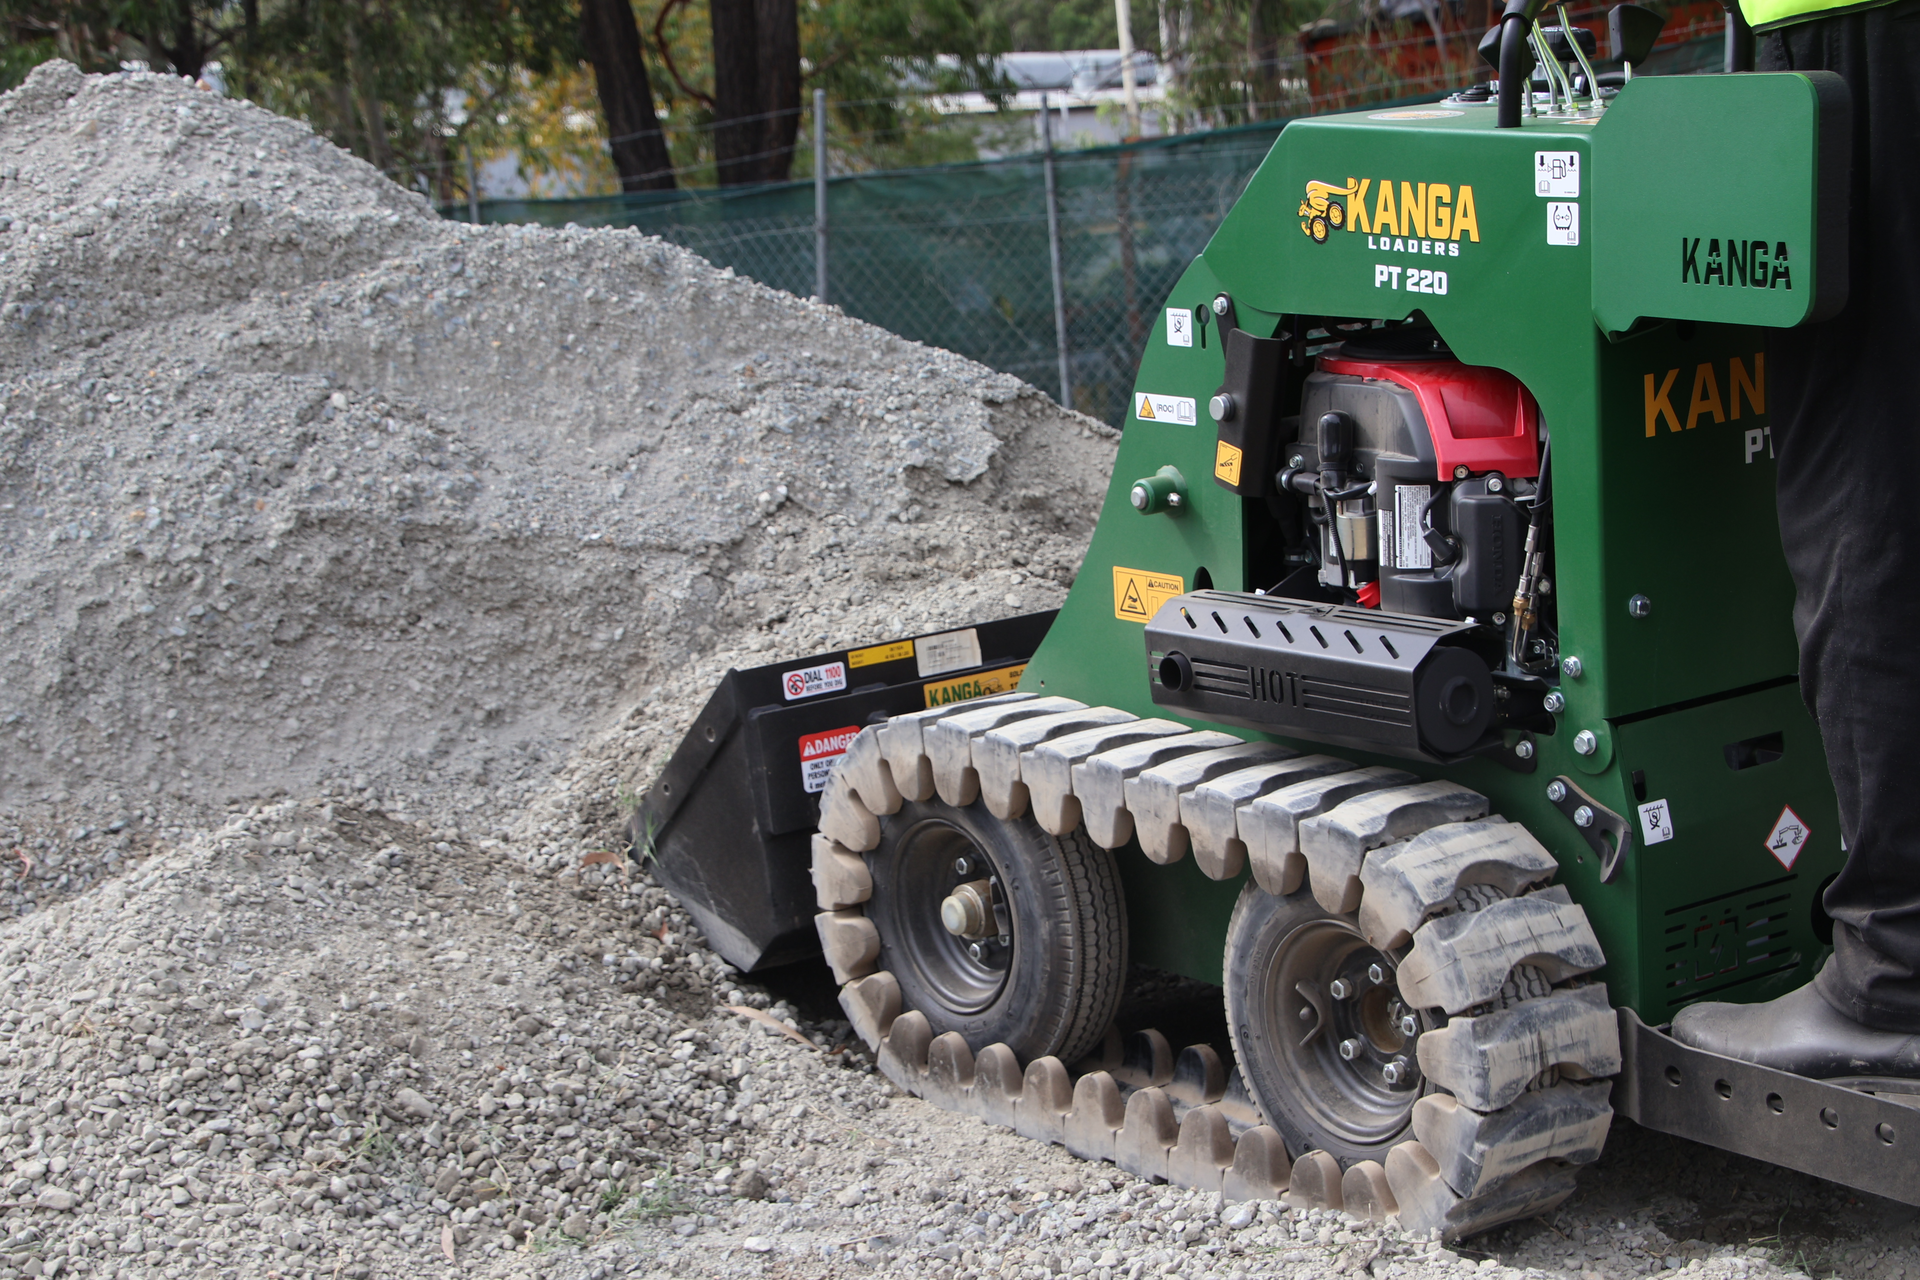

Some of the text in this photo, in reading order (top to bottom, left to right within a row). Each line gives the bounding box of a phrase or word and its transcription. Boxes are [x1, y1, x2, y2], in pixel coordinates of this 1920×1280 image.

[1346, 177, 1481, 243] KANGA
[1368, 235, 1460, 257] LOADERS
[1682, 237, 1792, 291] KANGA
[1374, 264, 1448, 296] PT 220
[1156, 403, 1175, 414] (ROC)
[1153, 581, 1179, 591] CAUTION
[804, 665, 842, 684] DIAL 1100
[806, 683, 823, 692] BEFORE
[824, 681, 834, 689] YOU
[928, 680, 983, 707] KANGA
[1250, 666, 1299, 708] HOT
[810, 761, 824, 771] ONLY
